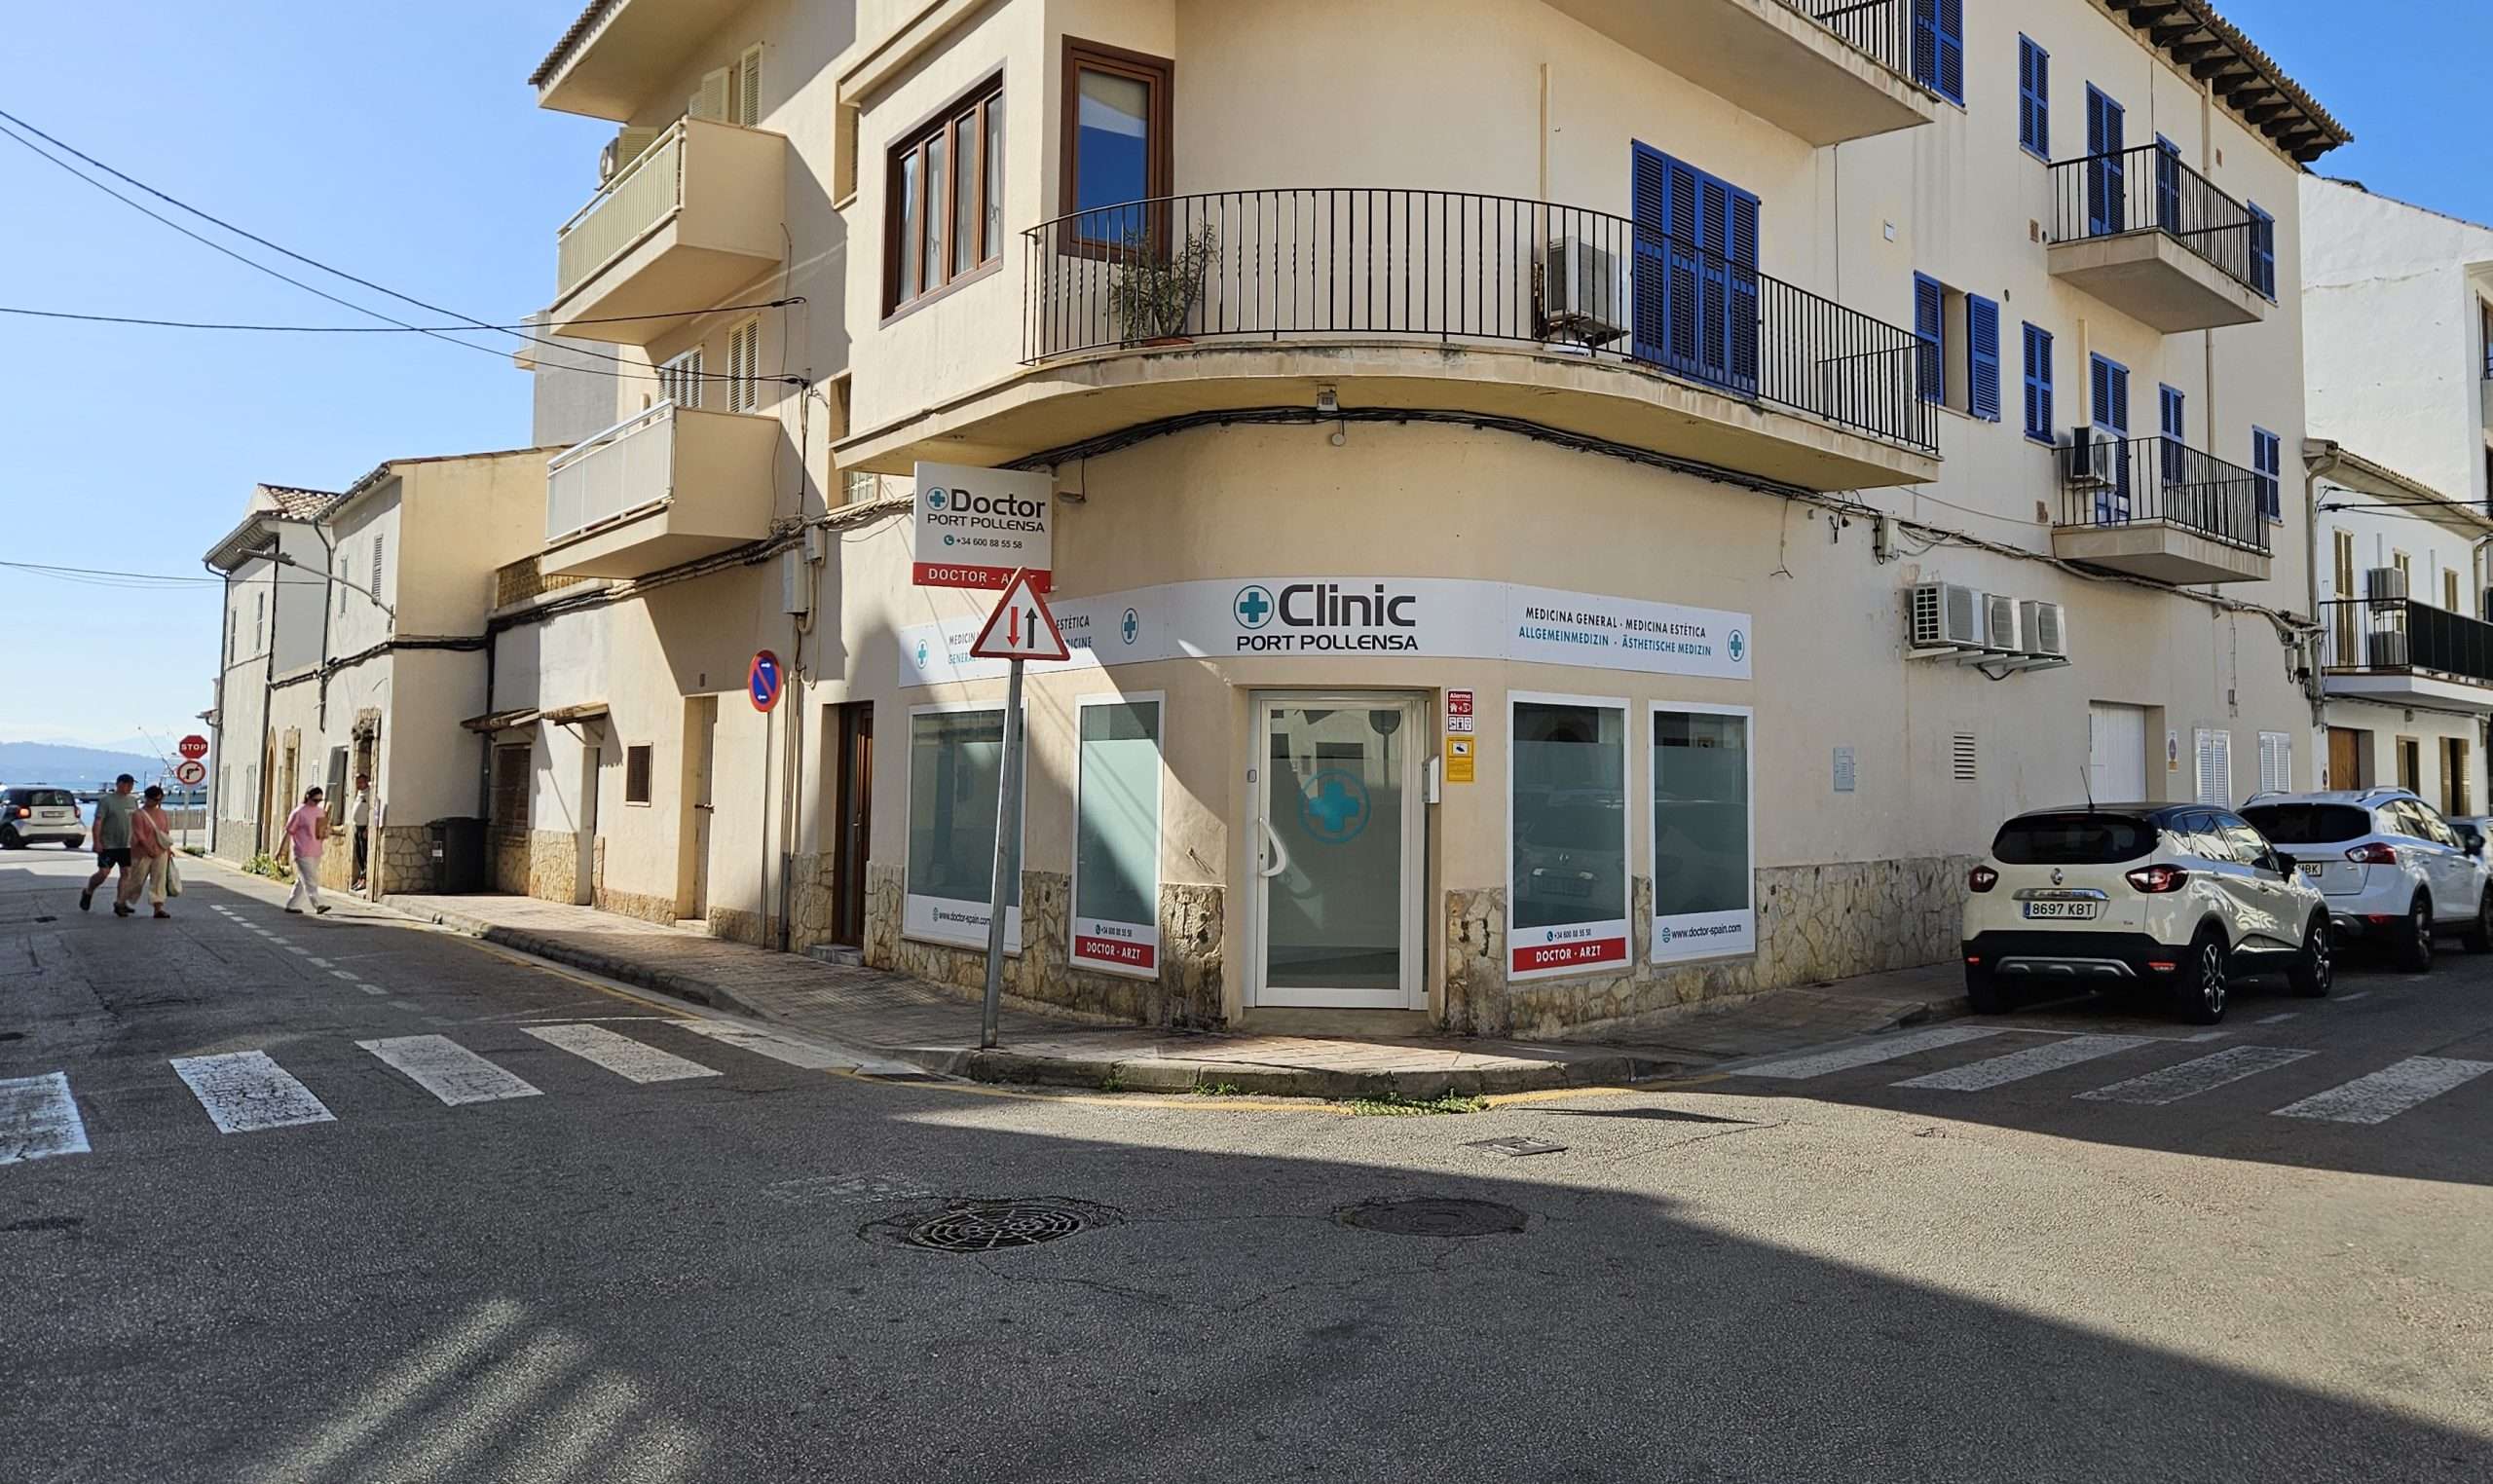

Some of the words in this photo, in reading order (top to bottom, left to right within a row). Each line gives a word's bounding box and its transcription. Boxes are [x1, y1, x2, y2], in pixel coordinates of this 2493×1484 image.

[950, 488, 1046, 518] Doctor
[927, 513, 968, 527] PORT
[970, 517, 1045, 533] POLLENSA
[956, 537, 971, 545] +34
[973, 538, 987, 546] 600
[989, 538, 999, 547] 88
[1001, 539, 1011, 548] 55
[1013, 540, 1023, 549] 58
[928, 568, 987, 583] DOCTOR
[1279, 583, 1416, 627] Clinic
[1525, 607, 1573, 623] MEDICINA
[1576, 612, 1618, 628] GENERAL
[1625, 618, 1668, 634] MEDICINA
[1670, 623, 1706, 638] ESTÉTICA
[949, 631, 980, 645] MEDICIN
[1237, 635, 1295, 650] PORT
[1300, 634, 1419, 650] POLLENSA
[1518, 626, 1609, 646] ALLGEMEINMEDIZIN
[1677, 643, 1712, 656] MEDIZIN
[2032, 903, 2065, 915] 8697
[2067, 903, 2093, 915] KBT
[1671, 923, 1742, 939] www.doctor-spain.com
[1086, 942, 1115, 956] DOCTOR
[1121, 946, 1141, 960] ARZT
[1536, 947, 1572, 962] DOCTOR
[1580, 945, 1601, 958] ARZT
